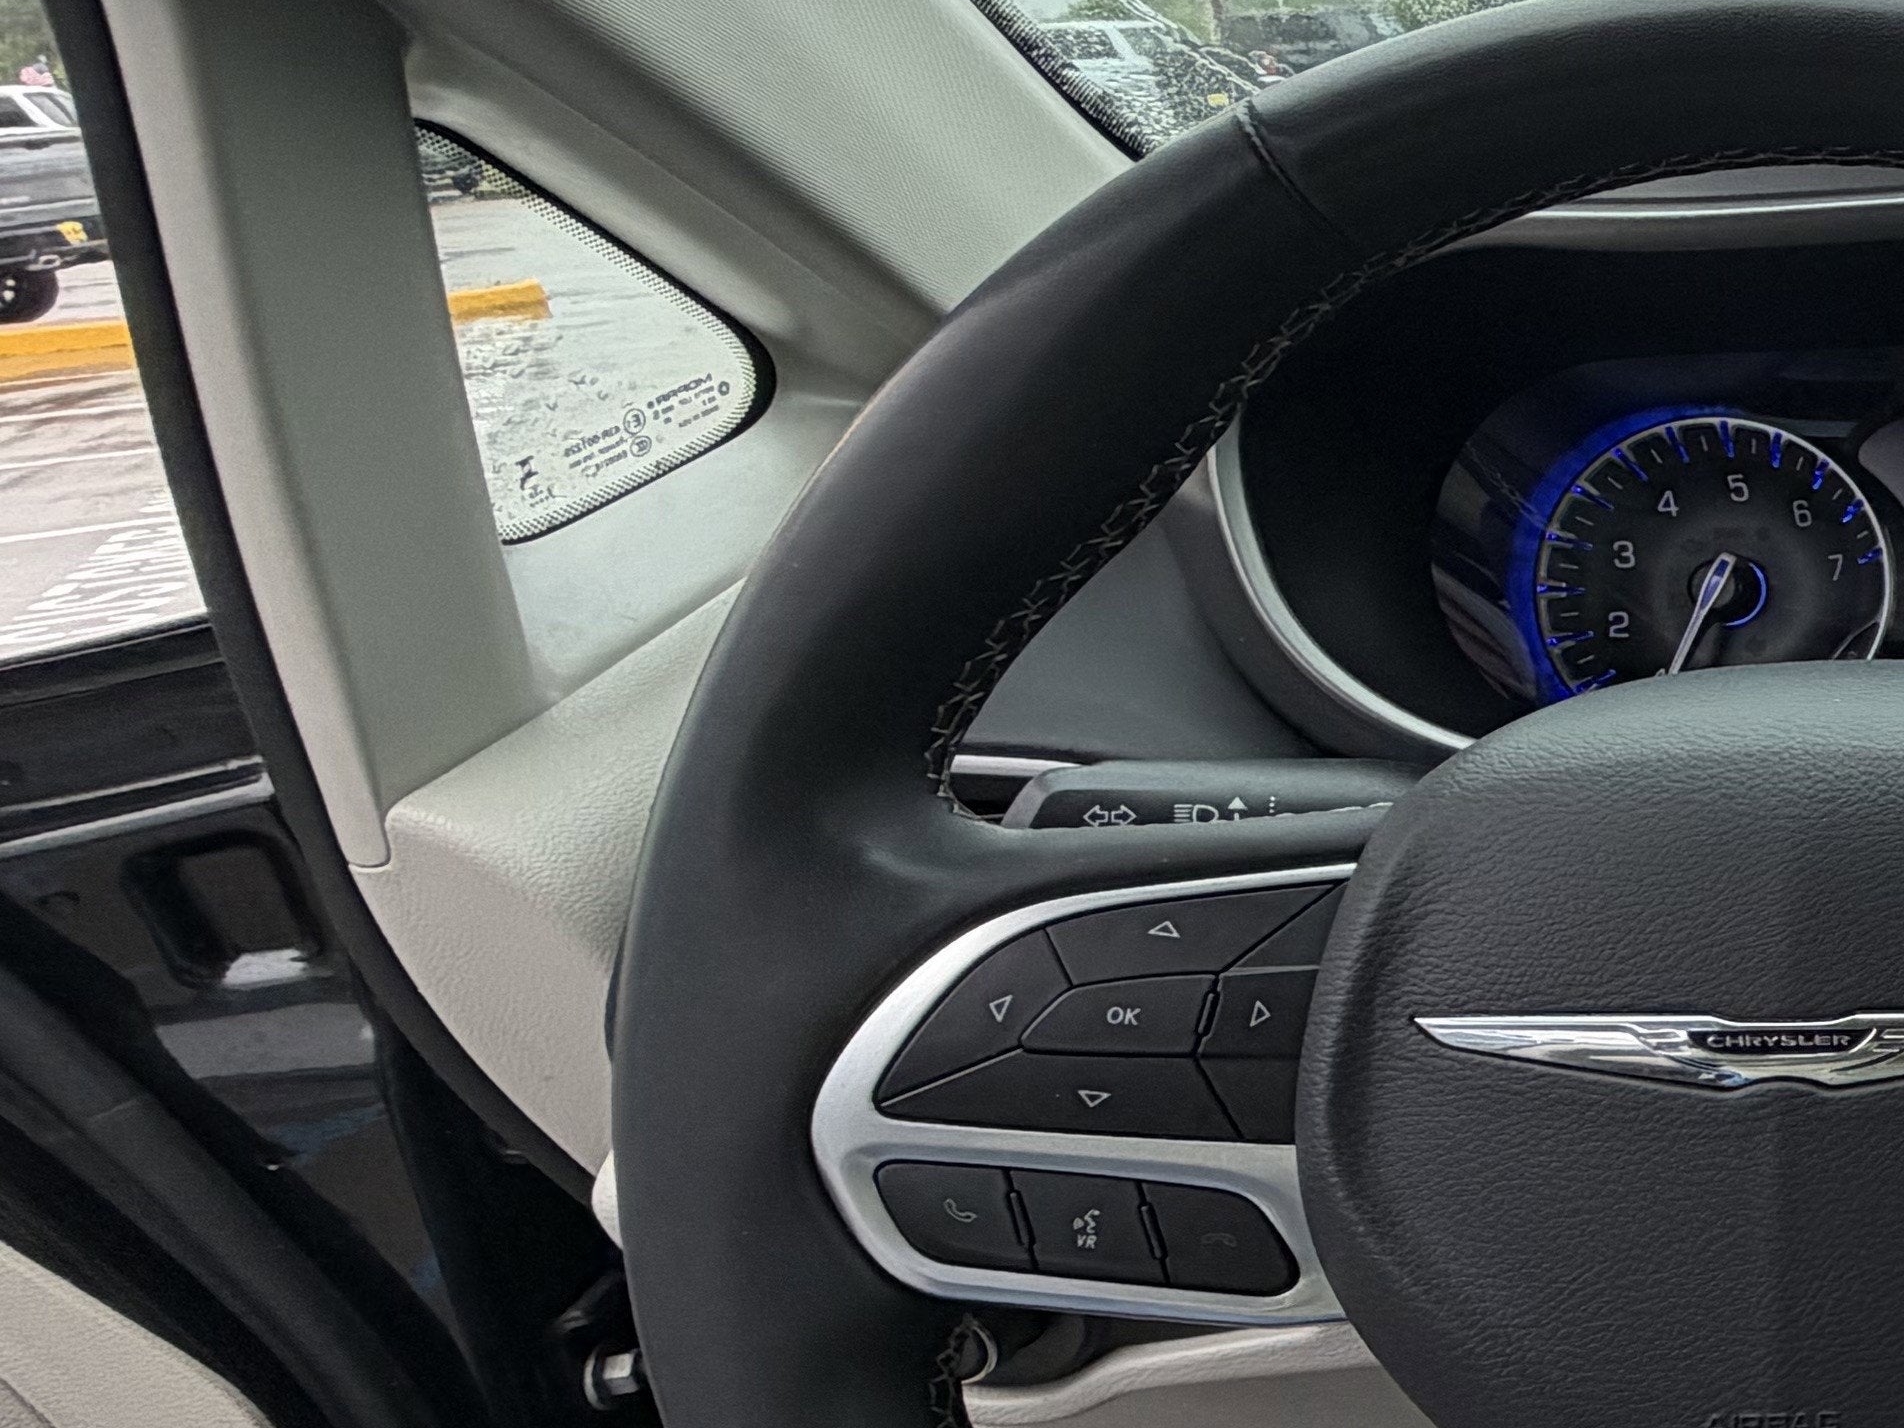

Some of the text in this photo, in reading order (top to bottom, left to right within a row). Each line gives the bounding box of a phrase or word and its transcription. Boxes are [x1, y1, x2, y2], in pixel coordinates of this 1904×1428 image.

[1727, 474, 1750, 503] 5
[1658, 490, 1680, 518] 4
[1793, 500, 1813, 527] 6
[1613, 540, 1636, 569] 3
[1828, 555, 1844, 581] 7
[1608, 610, 1630, 638] 2
[1106, 1007, 1141, 1025] OK
[1706, 1033, 1851, 1048] CHRYSLER
[1077, 1235, 1097, 1249] VR
